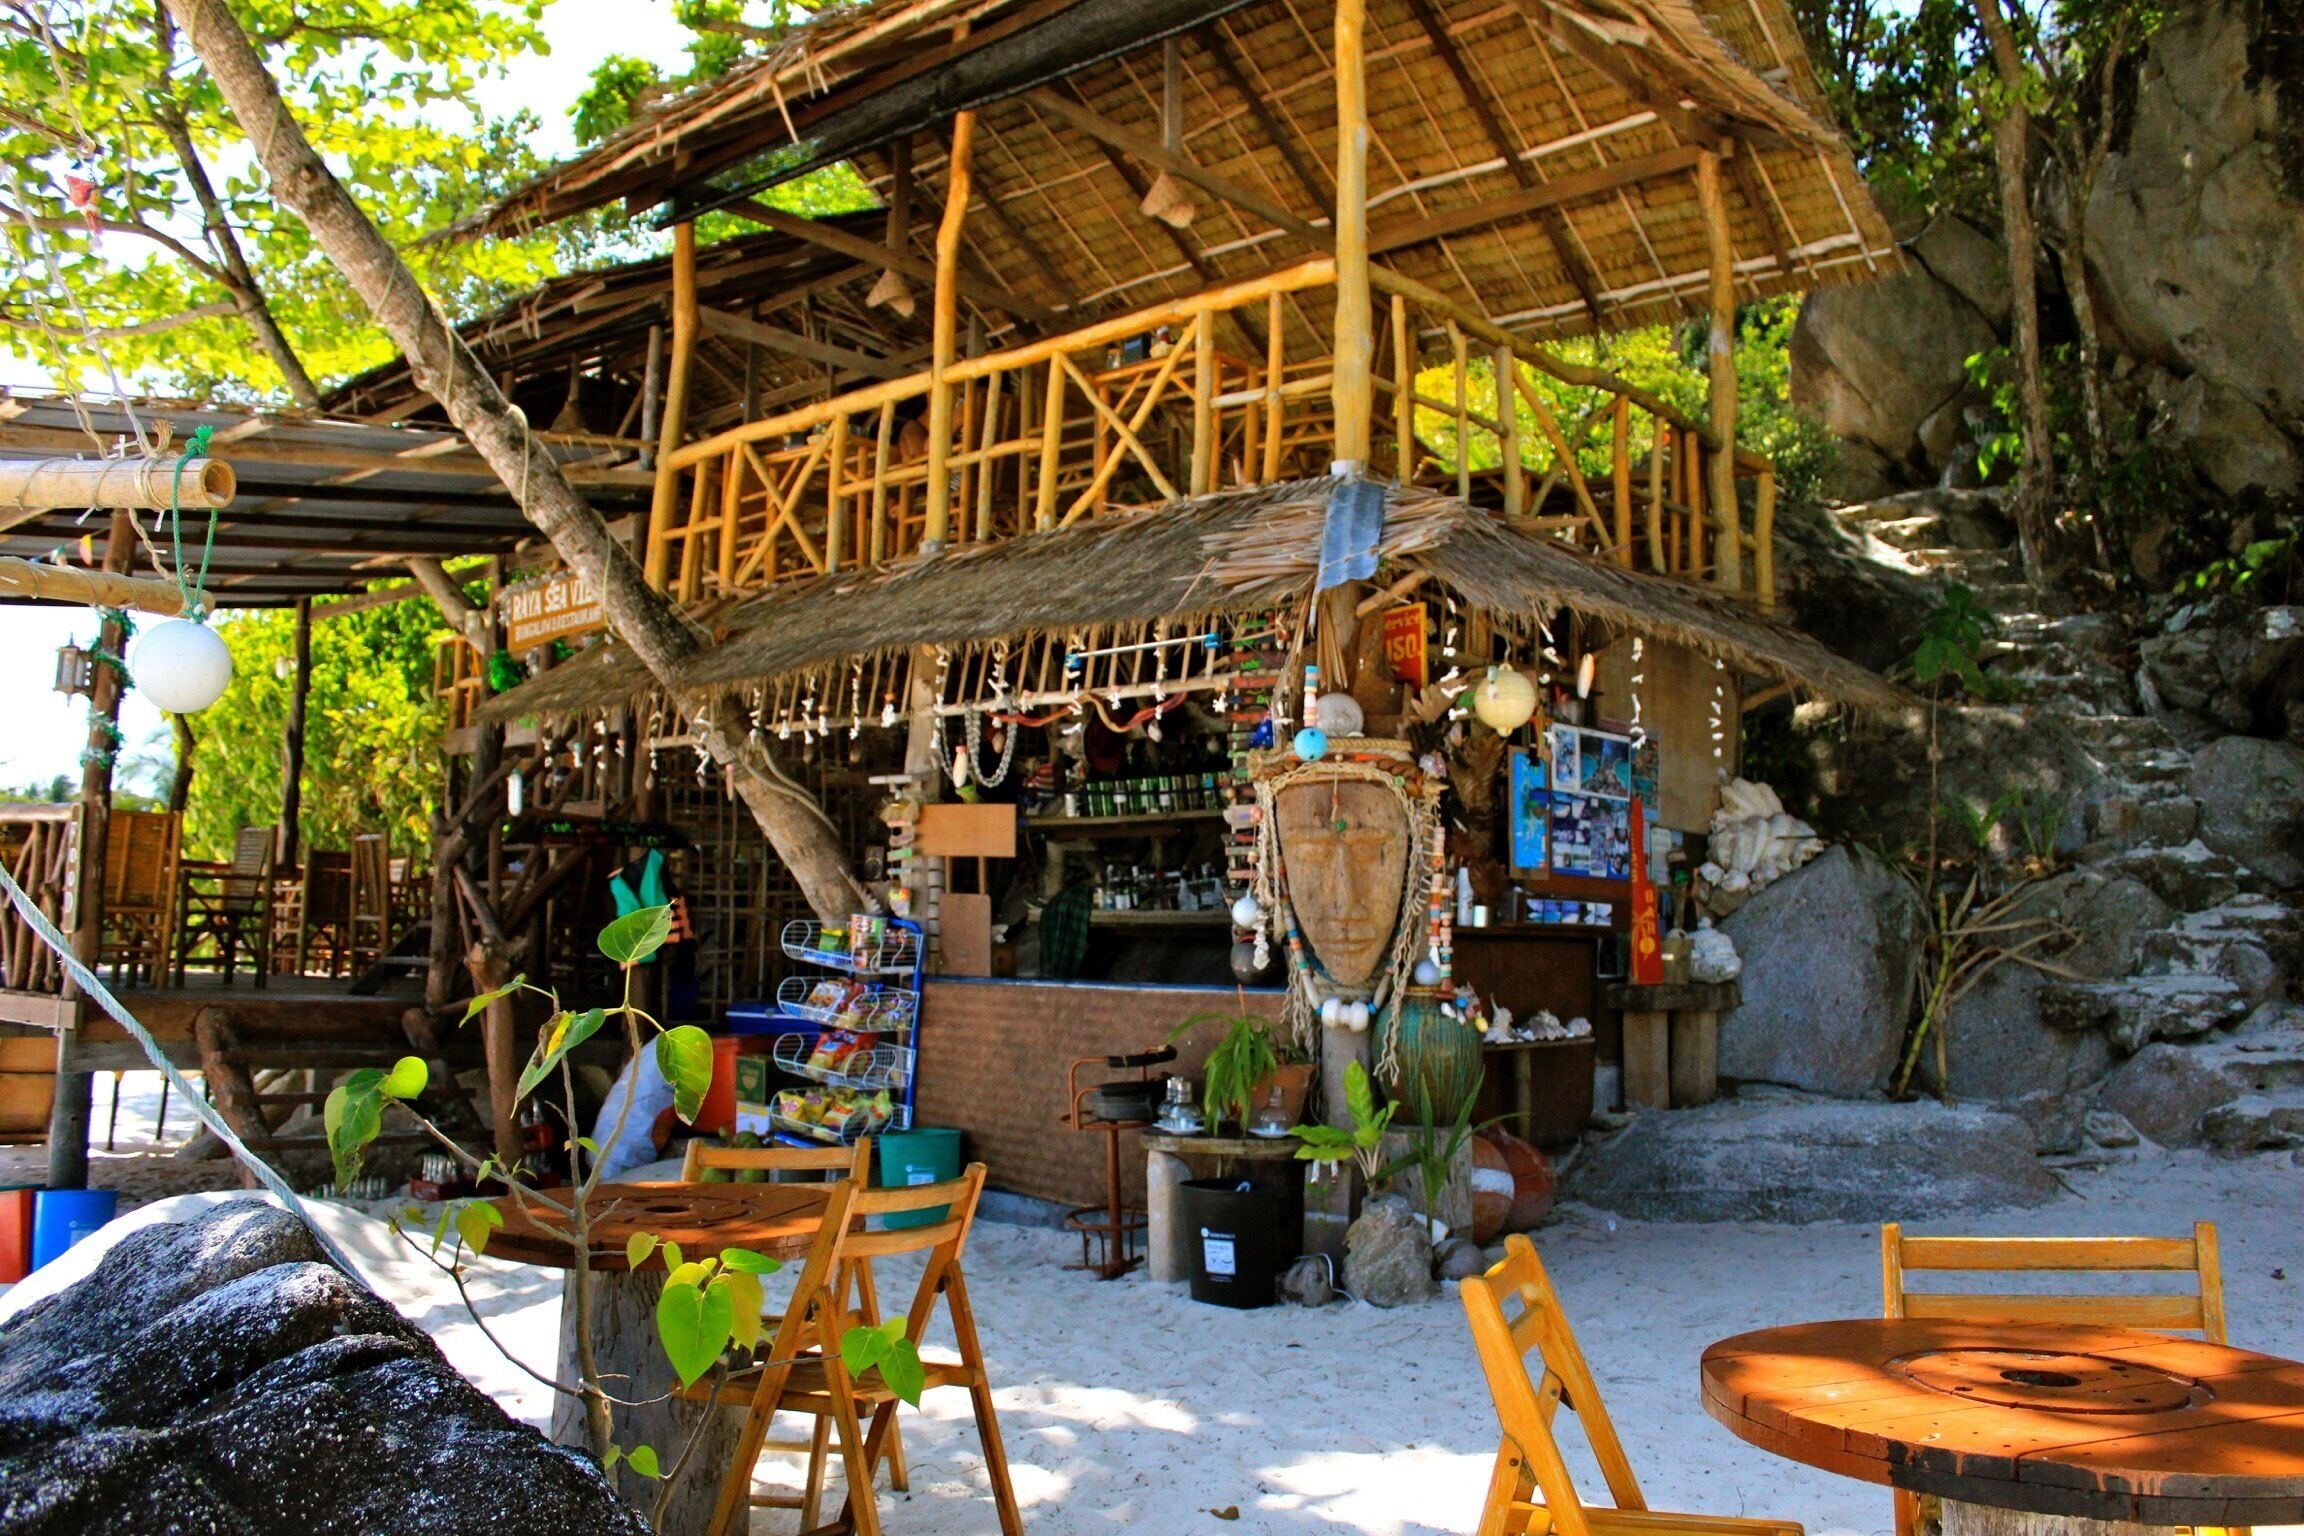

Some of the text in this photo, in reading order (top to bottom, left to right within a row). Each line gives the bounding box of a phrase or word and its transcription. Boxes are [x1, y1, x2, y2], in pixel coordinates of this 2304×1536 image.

[513, 579, 595, 621] RAYA SEA VIE
[1644, 889, 1656, 934] BAR
